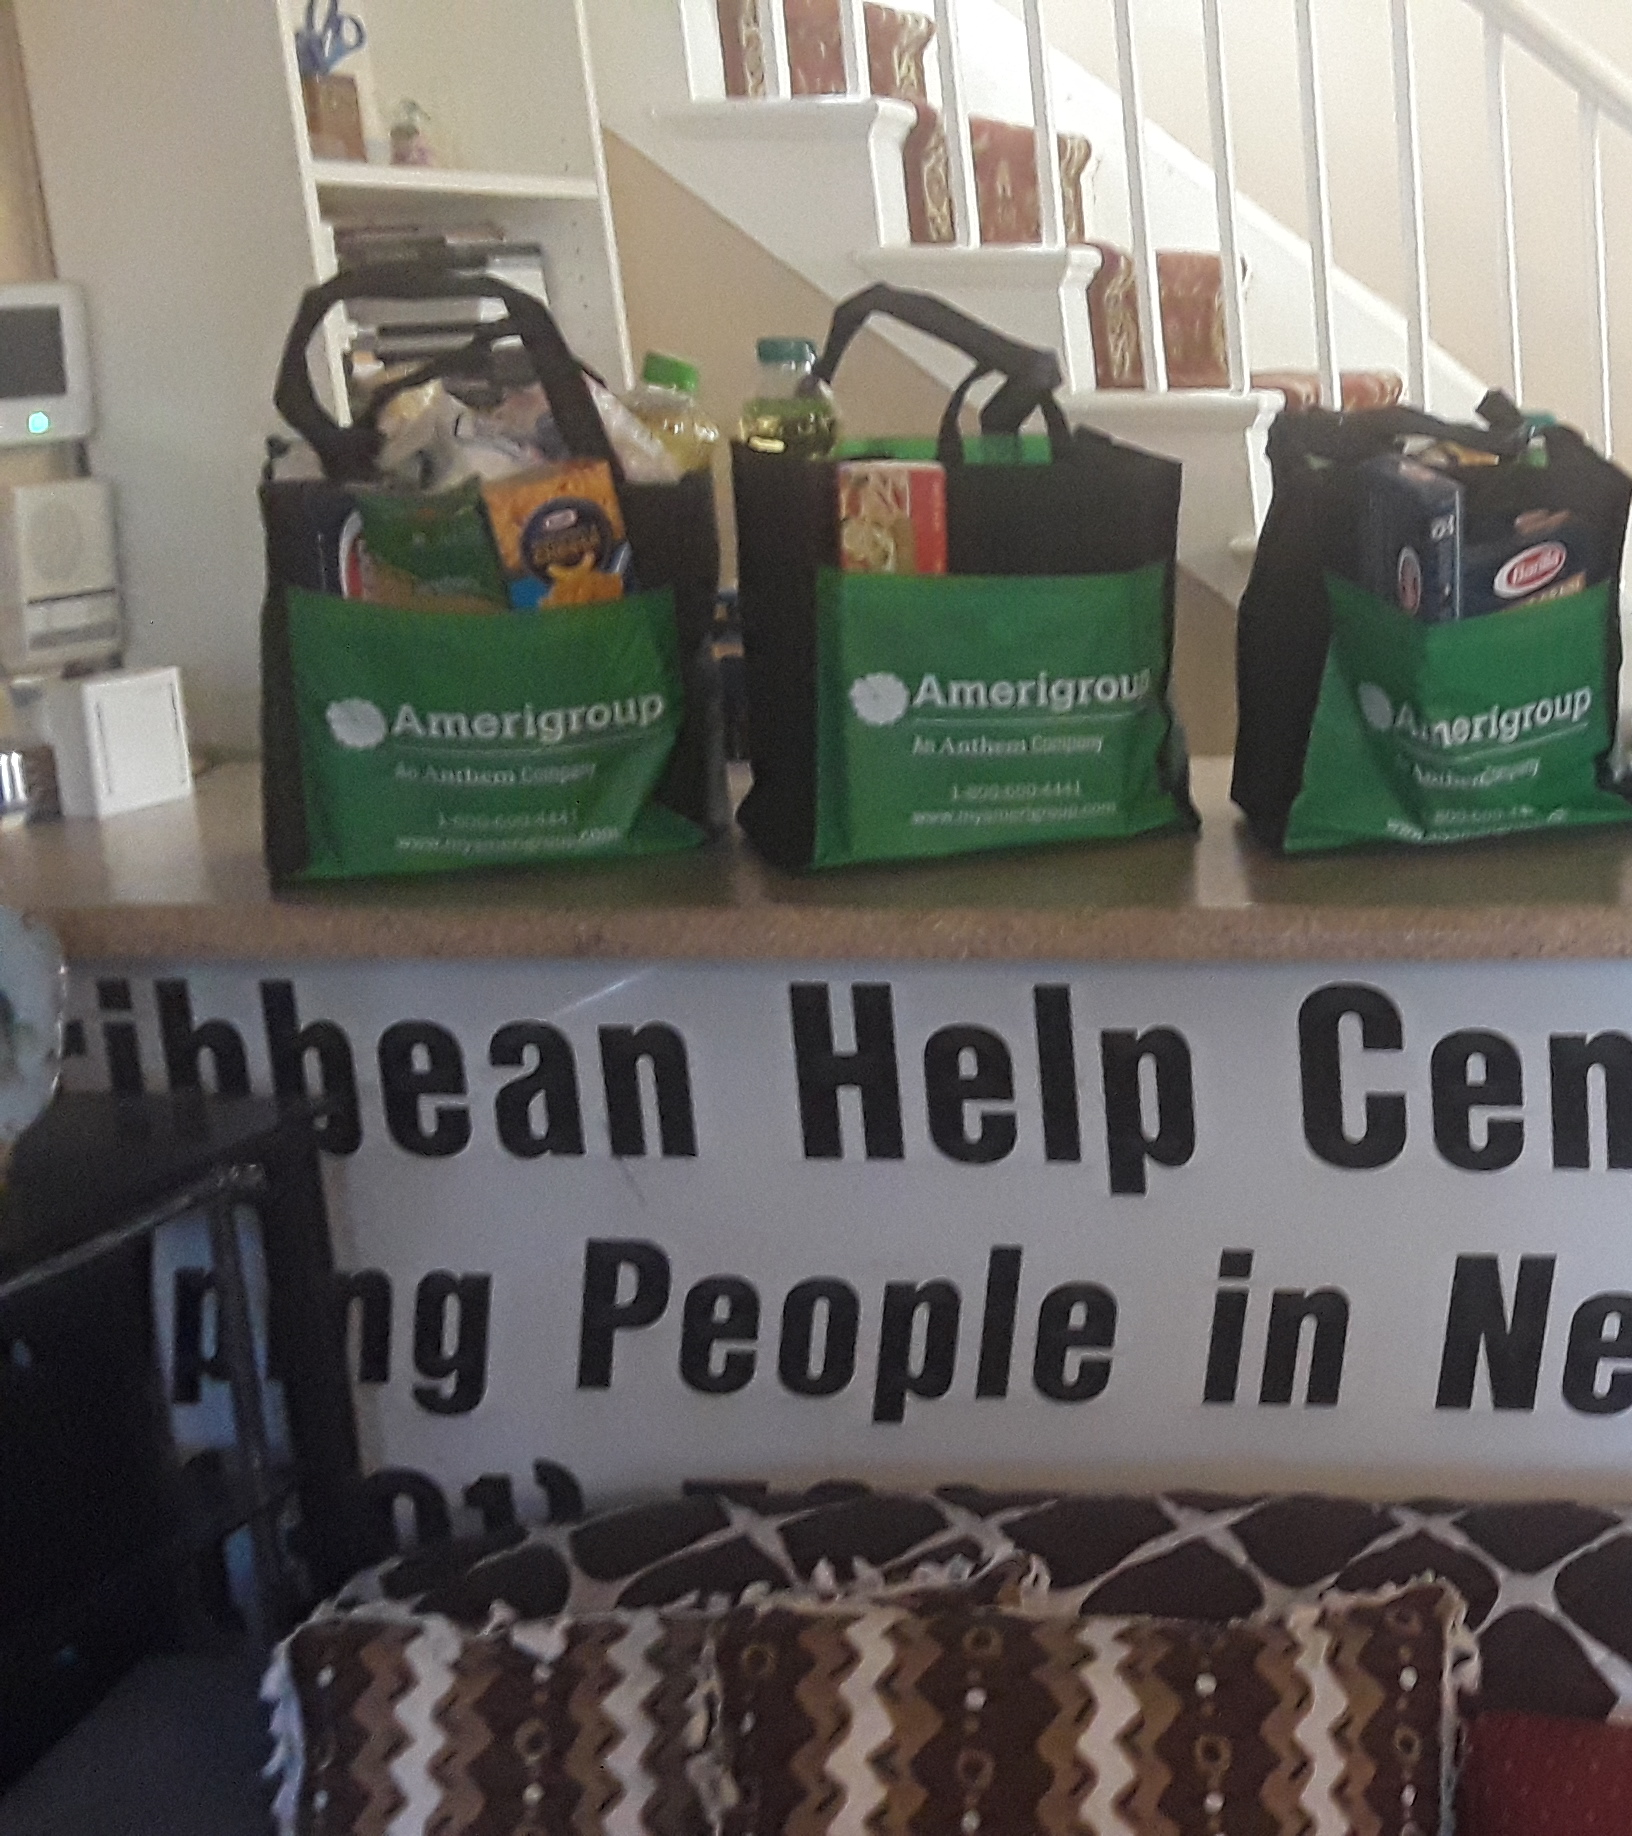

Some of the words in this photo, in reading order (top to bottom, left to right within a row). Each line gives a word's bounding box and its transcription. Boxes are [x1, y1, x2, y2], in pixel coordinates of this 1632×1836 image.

[391, 695, 664, 743] Amerigroup
[940, 735, 1026, 756] Anthem
[1031, 734, 1103, 756] Company
[424, 763, 517, 784] Anthem
[521, 763, 597, 784] Company
[789, 982, 1196, 1197] Help
[576, 1238, 1119, 1424] People
[1202, 1249, 1351, 1406] in
